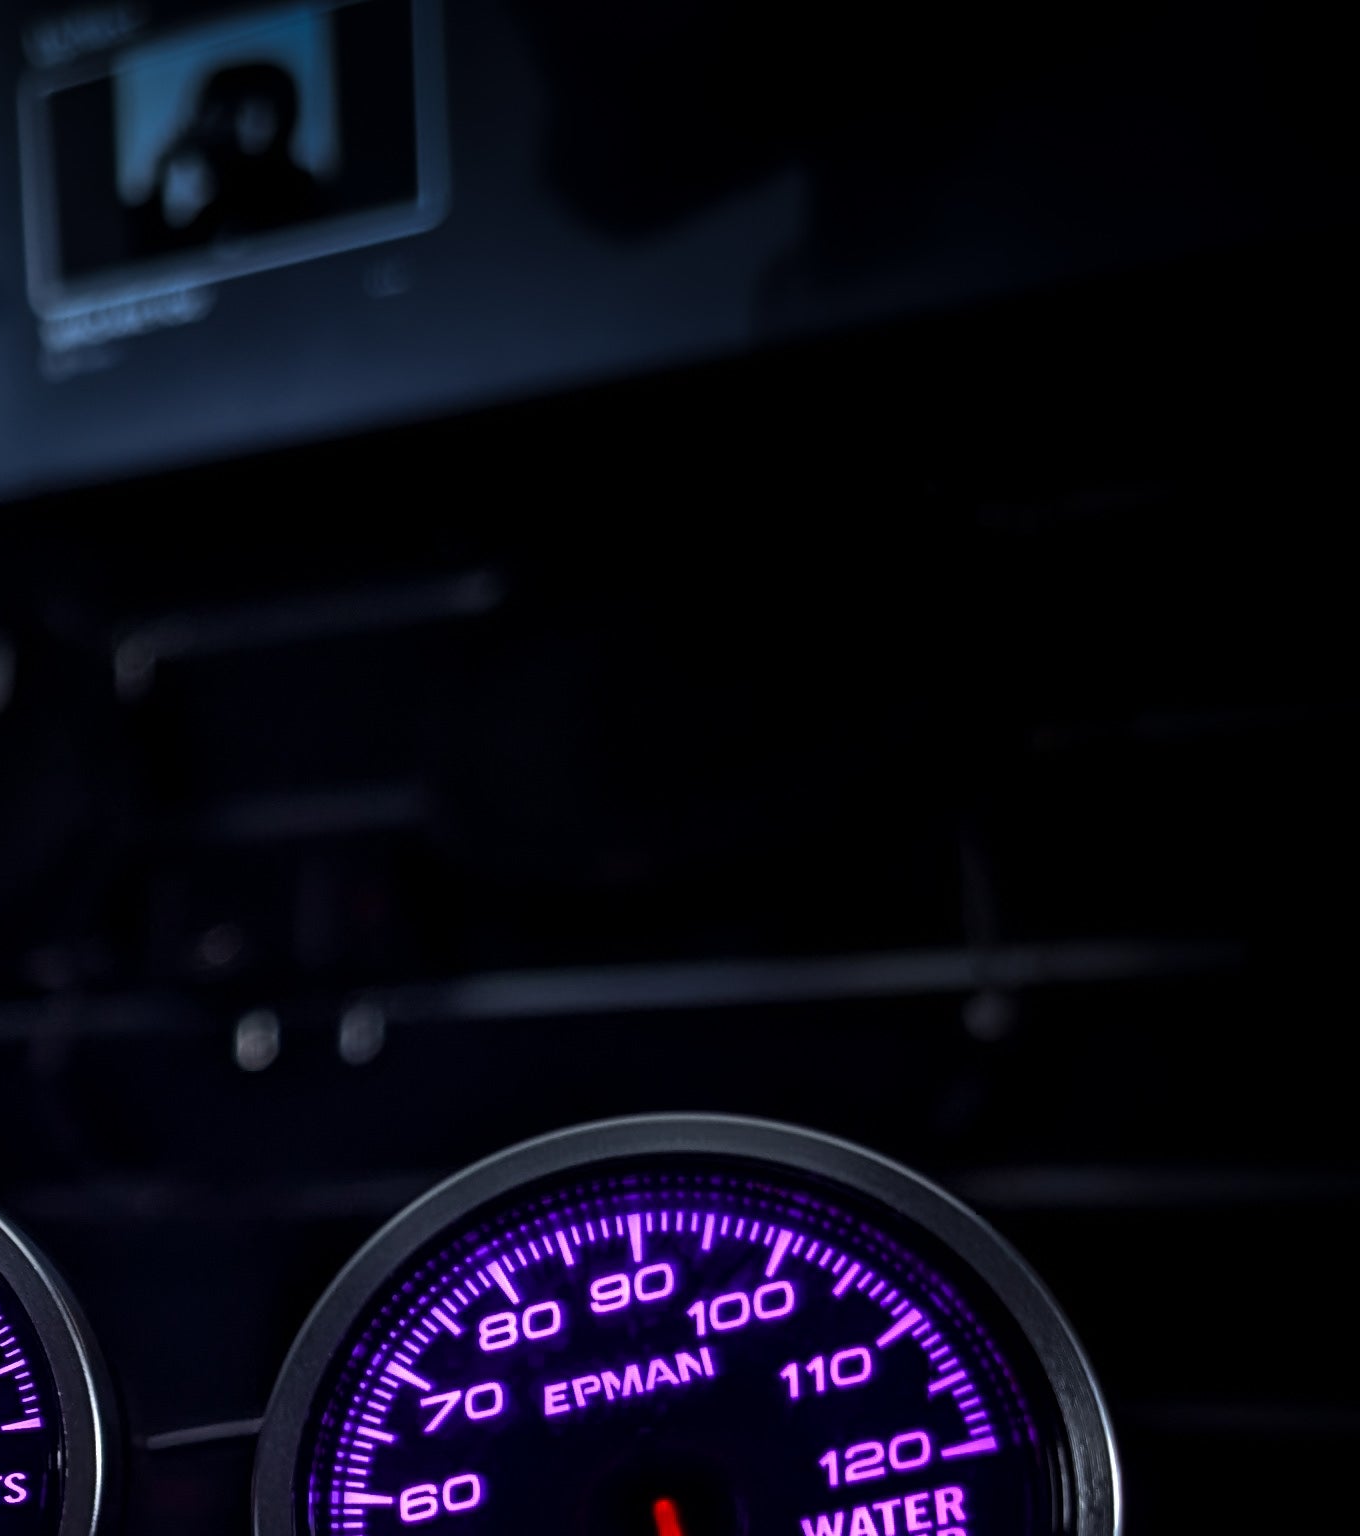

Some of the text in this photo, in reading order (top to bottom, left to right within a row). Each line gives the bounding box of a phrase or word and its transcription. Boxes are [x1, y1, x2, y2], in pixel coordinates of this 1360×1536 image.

[590, 1262, 676, 1314] 90
[687, 1280, 796, 1336] 100
[478, 1299, 563, 1352] 80
[543, 1347, 715, 1416] EPMAN
[780, 1346, 873, 1400] 110
[420, 1381, 504, 1433] 70
[819, 1430, 932, 1487] 120
[398, 1474, 482, 1522] 60
